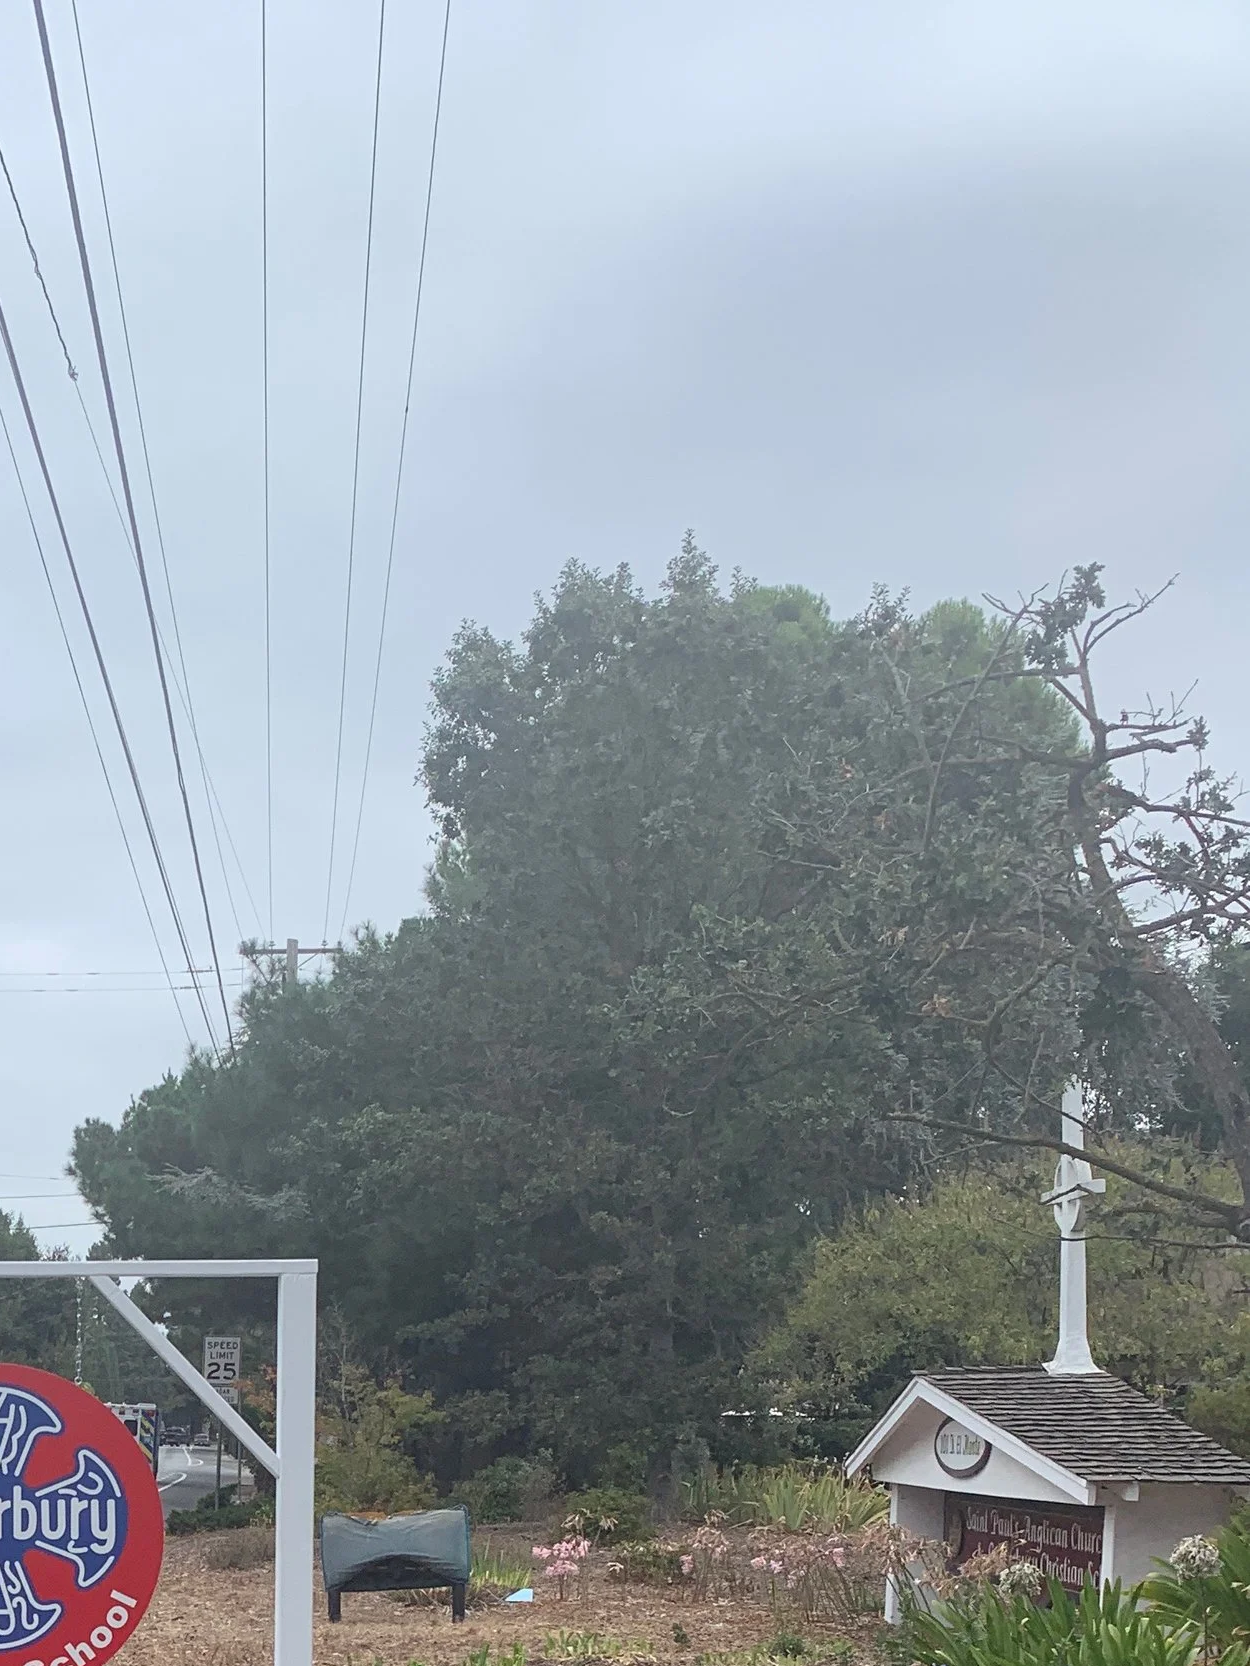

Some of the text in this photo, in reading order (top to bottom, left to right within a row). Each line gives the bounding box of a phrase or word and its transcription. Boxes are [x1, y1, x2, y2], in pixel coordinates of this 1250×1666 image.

[207, 1341, 238, 1350] SPEED
[210, 1351, 234, 1360] LIMIT
[207, 1362, 236, 1380] 25
[966, 1506, 988, 1533] Saint
[1024, 1515, 1068, 1553] Anglican
[1071, 1522, 1102, 1554] Churc
[1040, 1551, 1084, 1586] Christian
